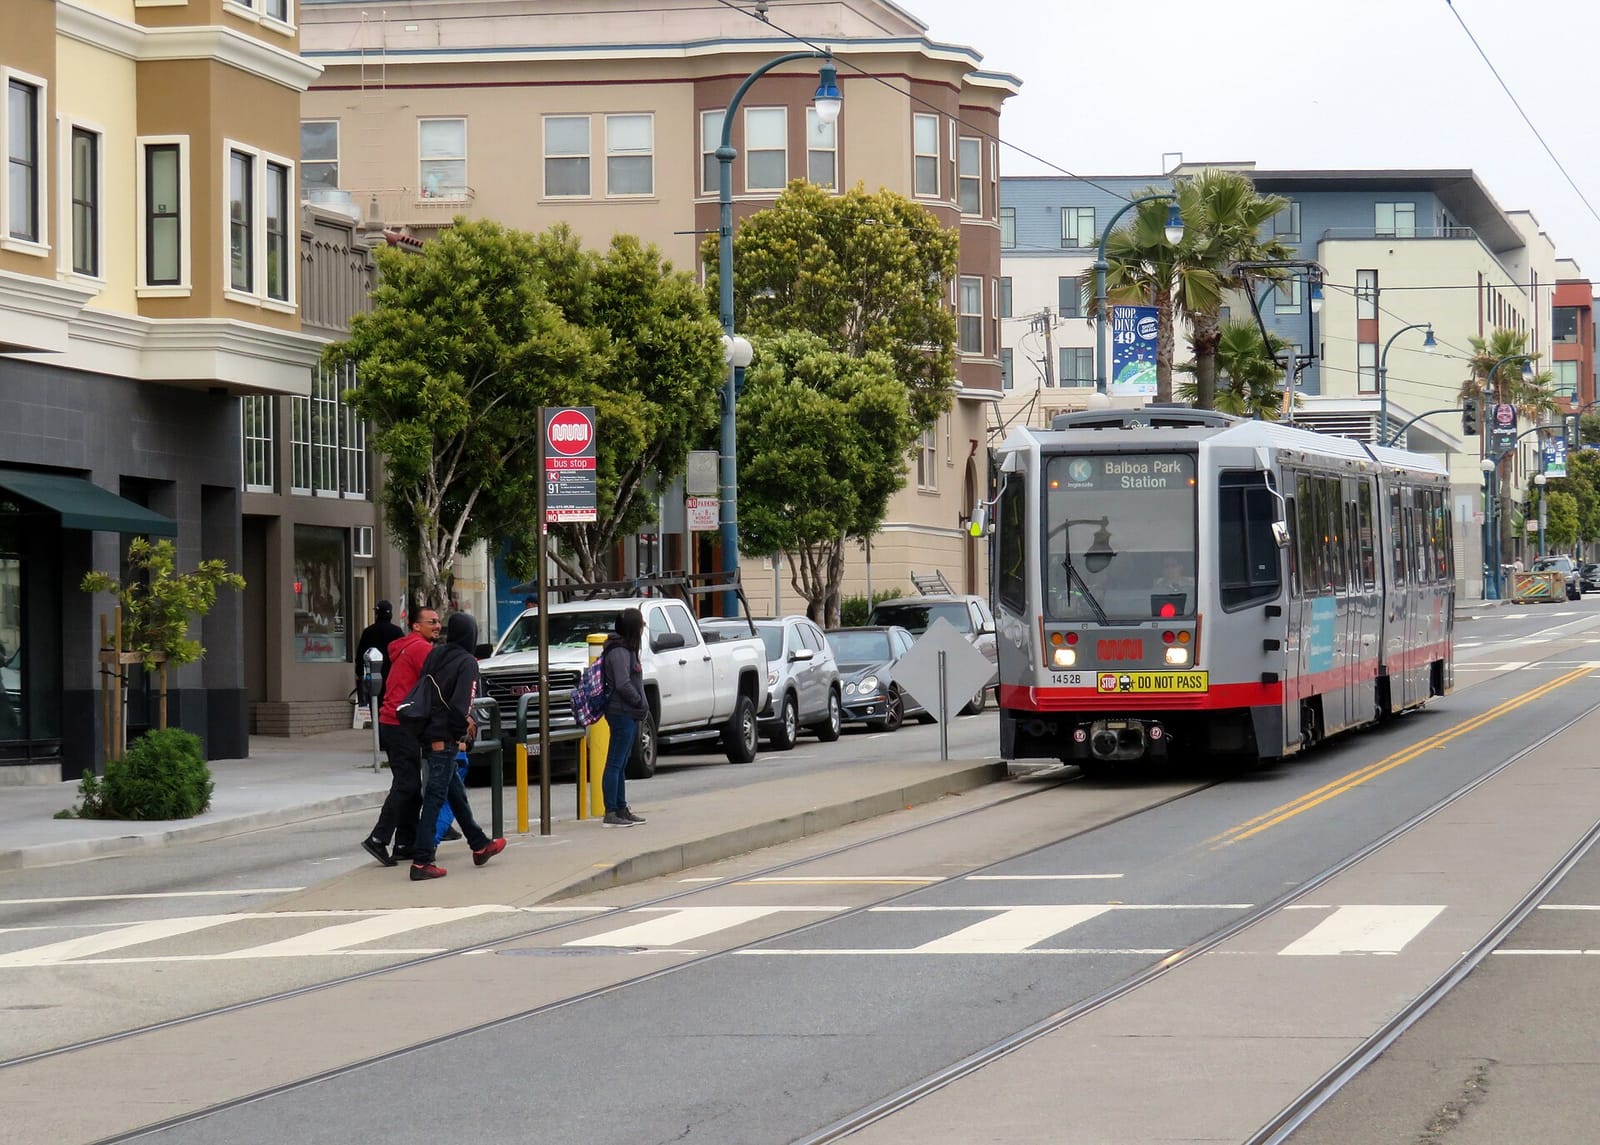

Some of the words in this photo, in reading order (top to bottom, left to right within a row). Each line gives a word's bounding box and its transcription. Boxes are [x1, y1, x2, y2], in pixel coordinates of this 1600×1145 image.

[1114, 307, 1136, 319] SHOP
[1114, 319, 1136, 331] DINE
[1114, 331, 1136, 344] 49
[553, 459, 568, 468] bus
[570, 459, 587, 469] stop
[1074, 463, 1087, 478] K
[1105, 461, 1148, 474] Balboa
[1153, 460, 1181, 473] Park
[1121, 475, 1167, 488] Station
[548, 483, 559, 494] 91
[688, 499, 697, 508] NO
[697, 500, 718, 508] PARKING
[1052, 674, 1081, 684] 1452B
[1101, 677, 1116, 689] STOP
[1138, 676, 1151, 689] DO
[1155, 675, 1174, 689] NOT
[1177, 675, 1202, 689] PASS
[510, 684, 541, 697] GM
